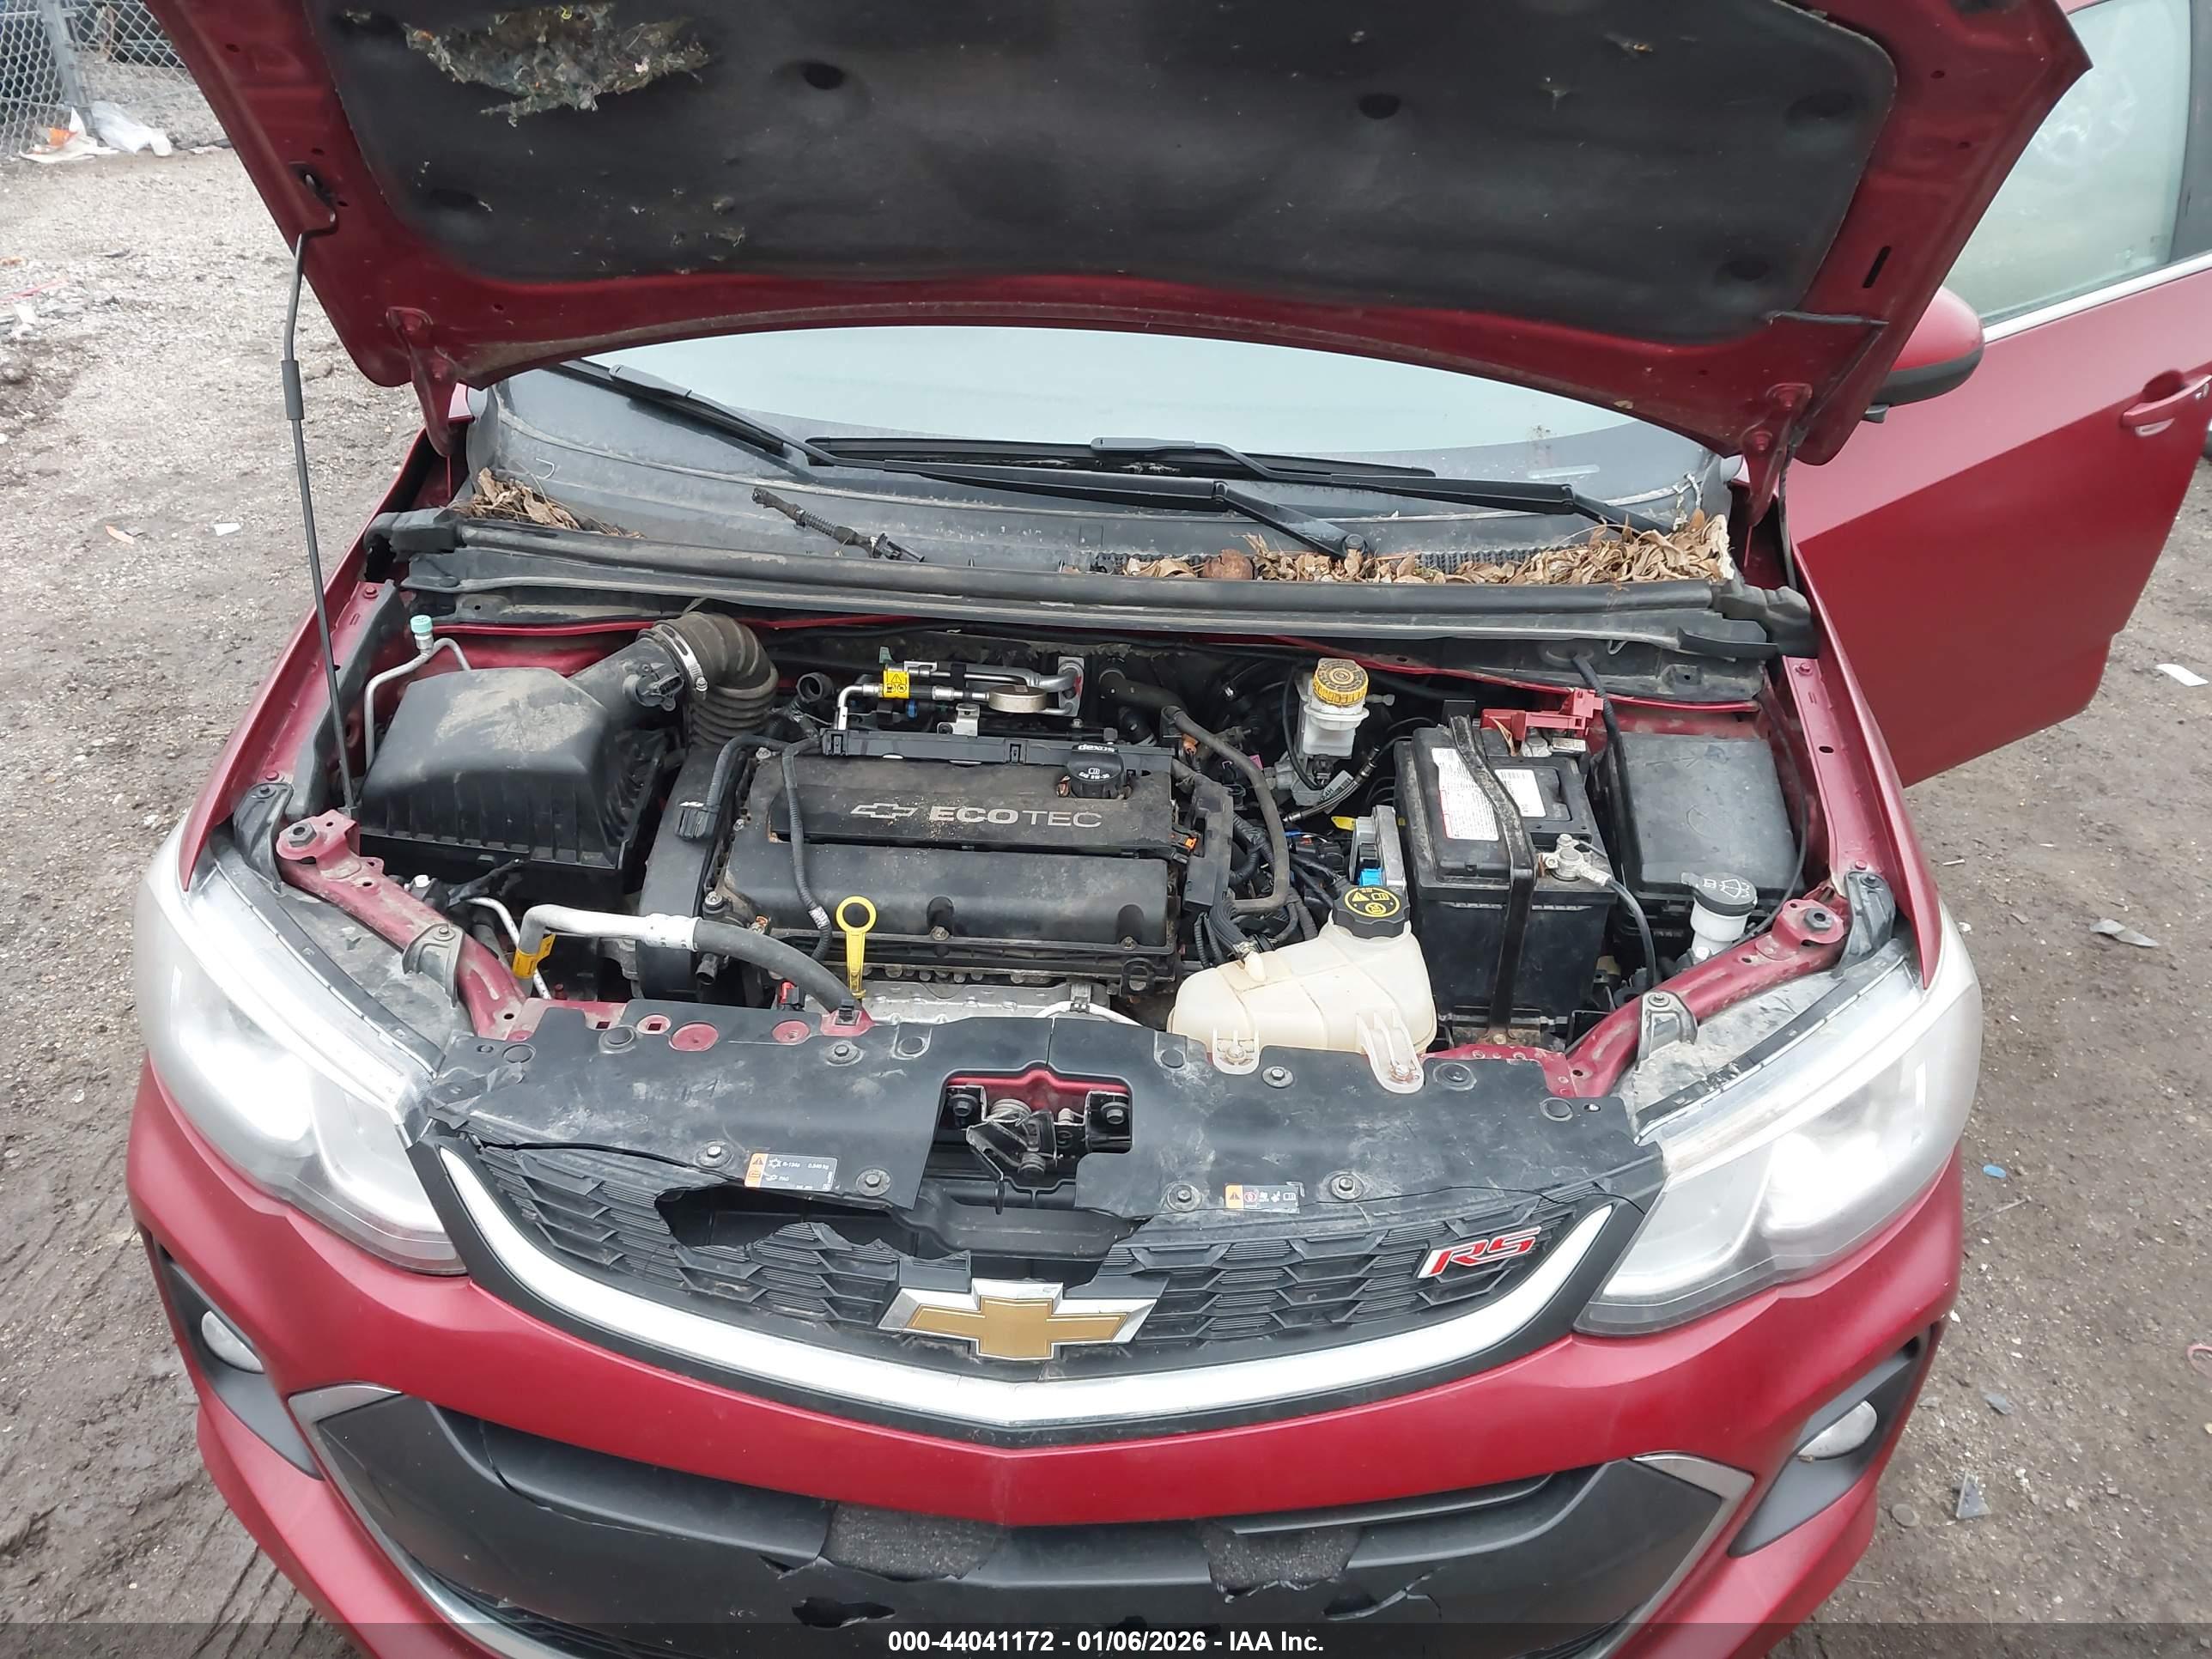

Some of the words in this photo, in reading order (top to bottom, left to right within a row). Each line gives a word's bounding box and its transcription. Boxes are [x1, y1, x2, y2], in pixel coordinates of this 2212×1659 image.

[1078, 744, 1115, 753] dexos
[929, 805, 1103, 829] ECOTEC
[1417, 1225, 1542, 1279] RS
